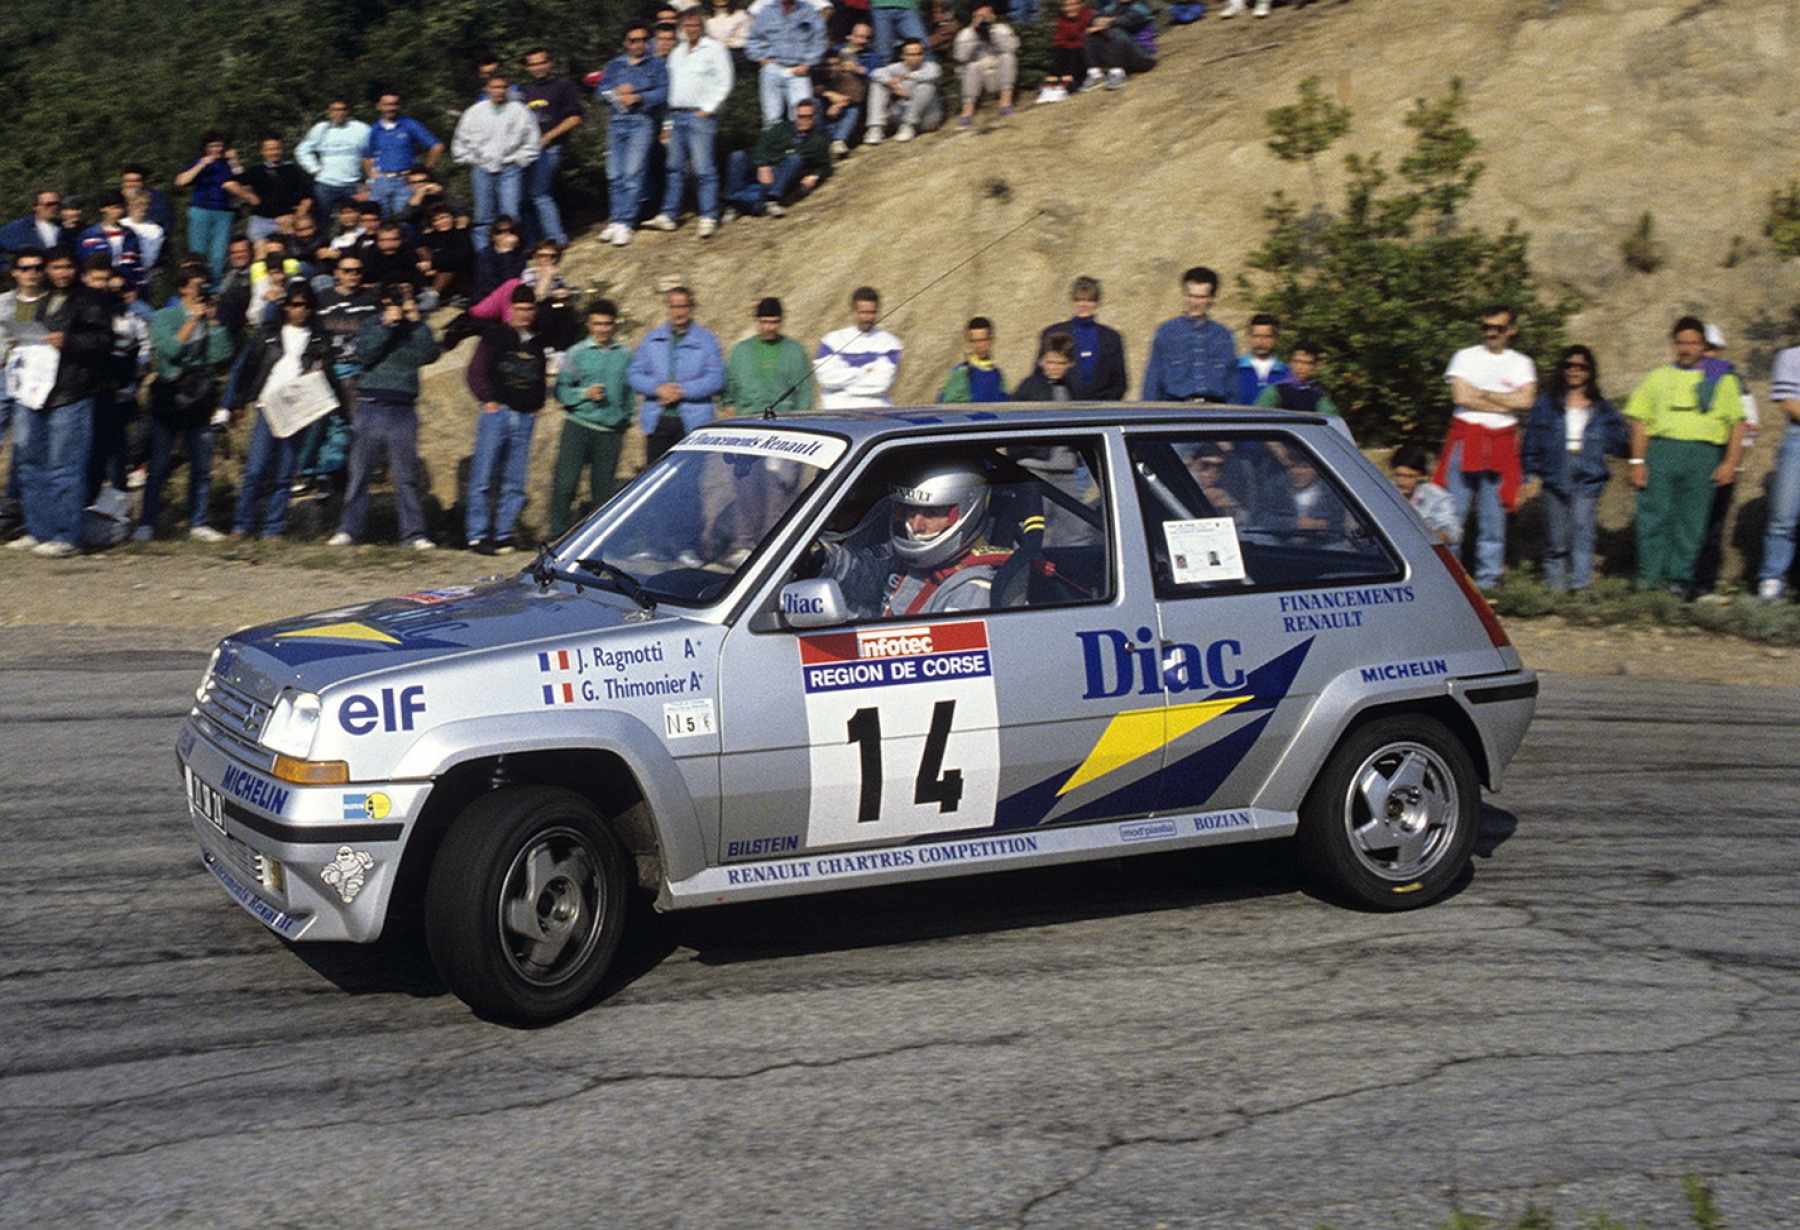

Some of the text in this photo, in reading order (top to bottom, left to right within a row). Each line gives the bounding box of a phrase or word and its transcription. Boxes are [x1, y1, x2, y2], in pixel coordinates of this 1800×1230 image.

[759, 435, 824, 456] Renault
[1278, 586, 1415, 612] FINANCEMENTS
[1283, 611, 1363, 633] RENAULT
[576, 648, 589, 674] J.
[593, 641, 663, 672] Ragnotti
[809, 654, 987, 688] REGION DE CORSE
[1075, 626, 1246, 700] Diac
[1360, 659, 1448, 683] MICHELIN
[581, 680, 600, 701] G.
[602, 673, 686, 699] Thimonier
[338, 684, 426, 736] elf
[846, 699, 964, 824] 14
[221, 764, 289, 815] MICHELIN
[1193, 812, 1251, 831] BOZIAN
[727, 835, 799, 857] BILSTEIN
[727, 836, 1038, 884] RENAULT CHARTRES COMPETITION
